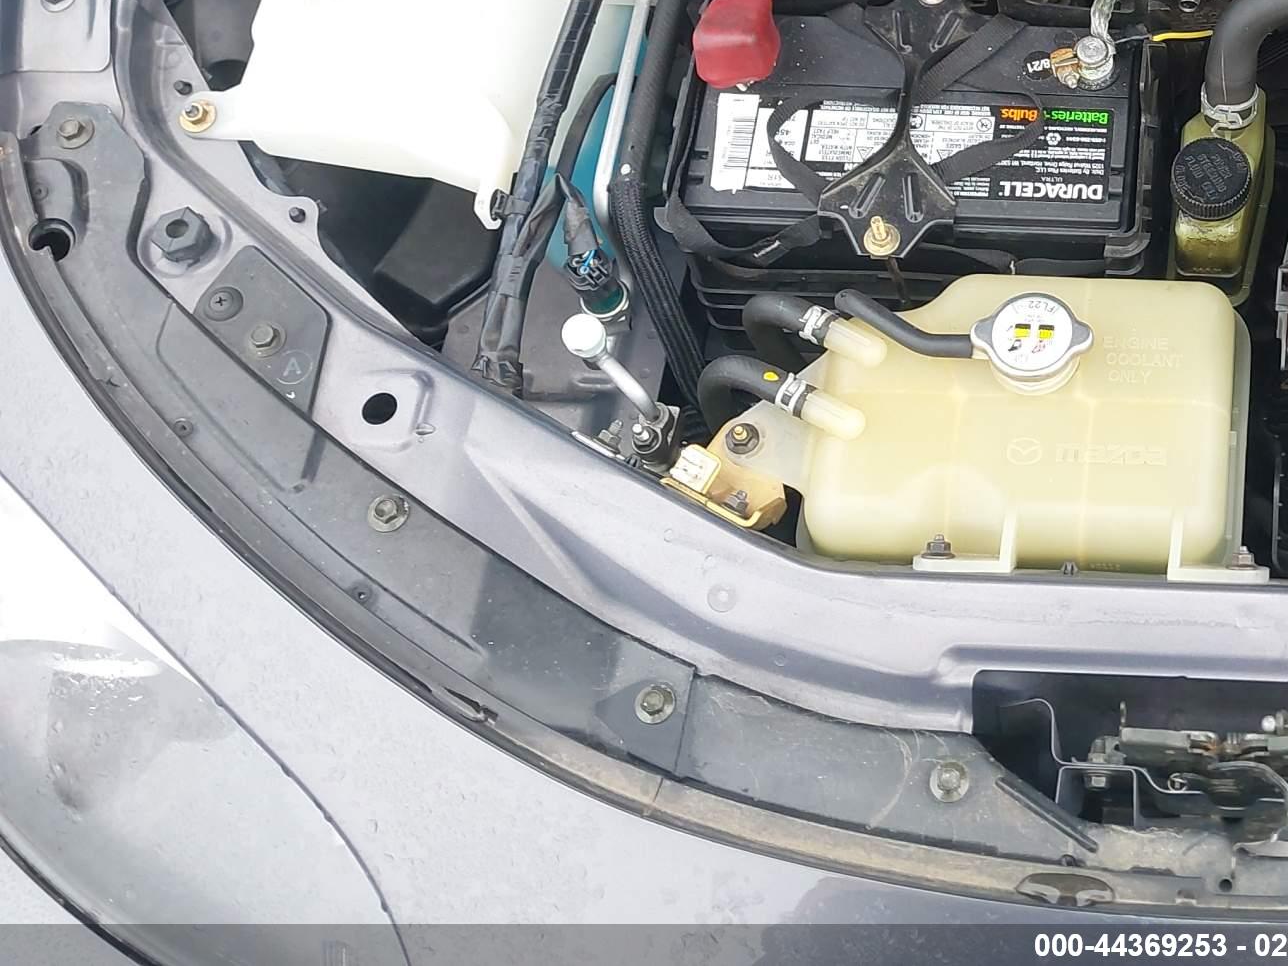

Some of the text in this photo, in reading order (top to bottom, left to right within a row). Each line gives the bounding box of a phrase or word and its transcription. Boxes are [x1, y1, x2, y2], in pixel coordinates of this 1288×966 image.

[1001, 108, 1038, 121] Bulbs
[1051, 110, 1108, 124] Batteries
[1000, 181, 1104, 200] DURACELL
[1028, 300, 1056, 313] FL22
[1103, 336, 1168, 350] ENGINE
[1106, 352, 1184, 368] COOLANT
[1108, 369, 1153, 384] ONLY
